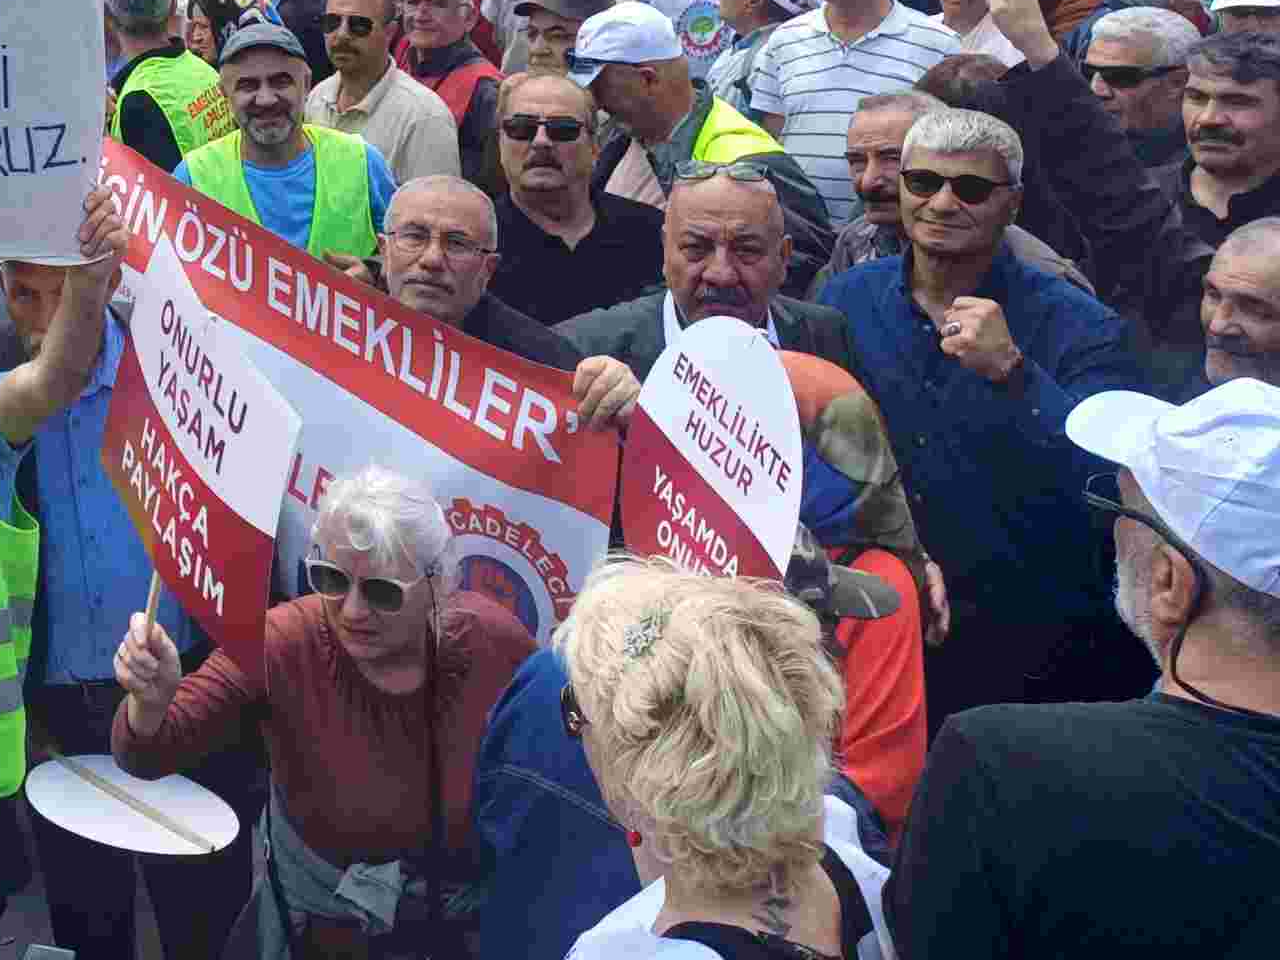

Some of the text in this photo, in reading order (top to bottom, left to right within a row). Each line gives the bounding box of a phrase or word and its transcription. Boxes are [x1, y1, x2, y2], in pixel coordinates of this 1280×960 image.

[175, 200, 254, 292] ÖZÜ
[156, 348, 226, 475] YAŞAM
[160, 298, 248, 434] ONURLU
[672, 351, 793, 494] EMEKLİLİKTE
[140, 418, 209, 549] HAKÇA
[685, 410, 755, 497] HUZUR
[120, 439, 225, 617] PAYLAŞIM
